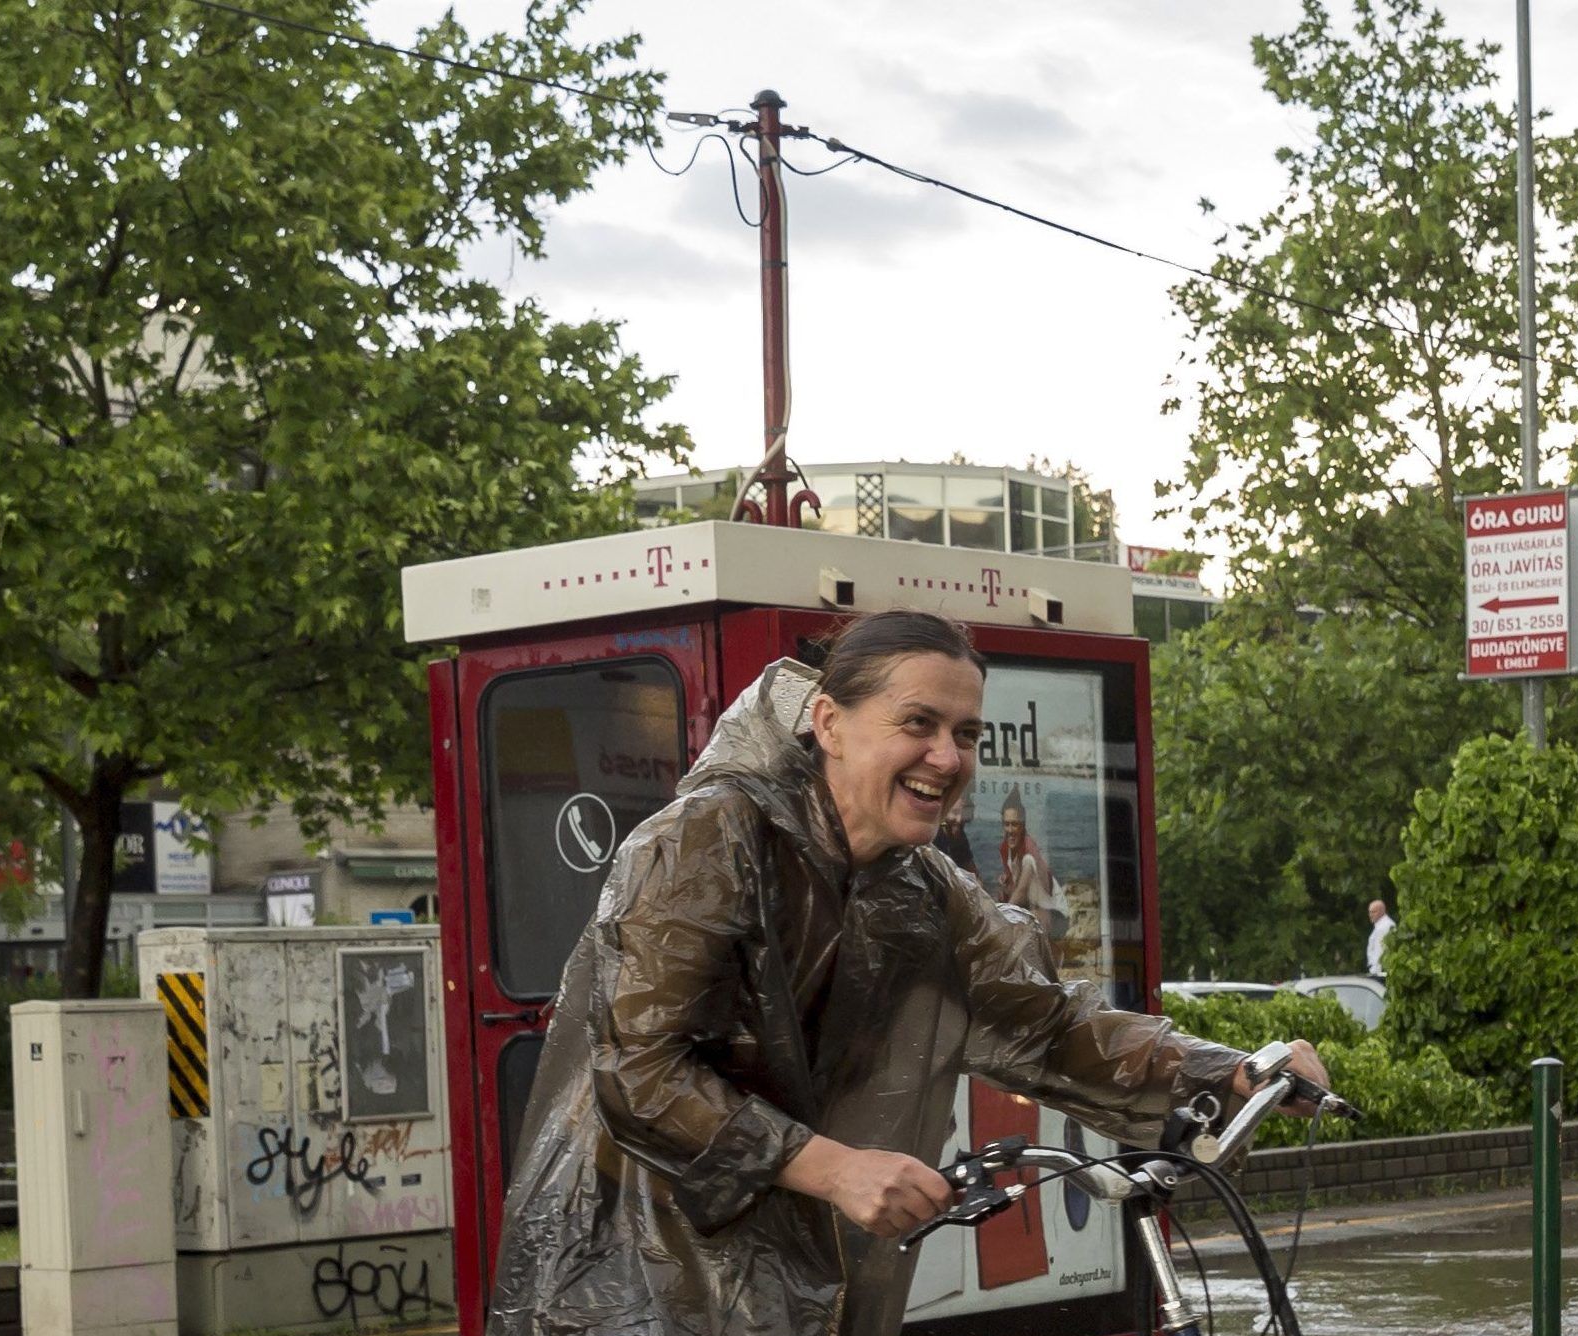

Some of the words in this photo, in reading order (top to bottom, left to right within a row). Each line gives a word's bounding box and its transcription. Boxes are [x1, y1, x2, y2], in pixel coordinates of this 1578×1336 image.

[1470, 507, 1510, 531] ÓRA
[1512, 504, 1564, 526] GURU
[1471, 542, 1492, 556] ÓRA
[1495, 535, 1563, 553] FELVÁSÁRLÁS
[647, 546, 672, 588] T
[1471, 558, 1501, 578] ÓRA
[1505, 552, 1563, 575] JAVÍTÁS
[981, 568, 1001, 607] T
[1498, 581, 1508, 593] ÉS
[1511, 578, 1563, 592] ELEMCSERE
[1472, 619, 1494, 635] 30/
[1498, 614, 1563, 632] 651-2559
[1471, 636, 1564, 658] BUDAGYÖNGYE
[1504, 656, 1539, 669] EMELET
[980, 779, 1041, 796] STOES
[1059, 1267, 1112, 1287] dockyard.hu
